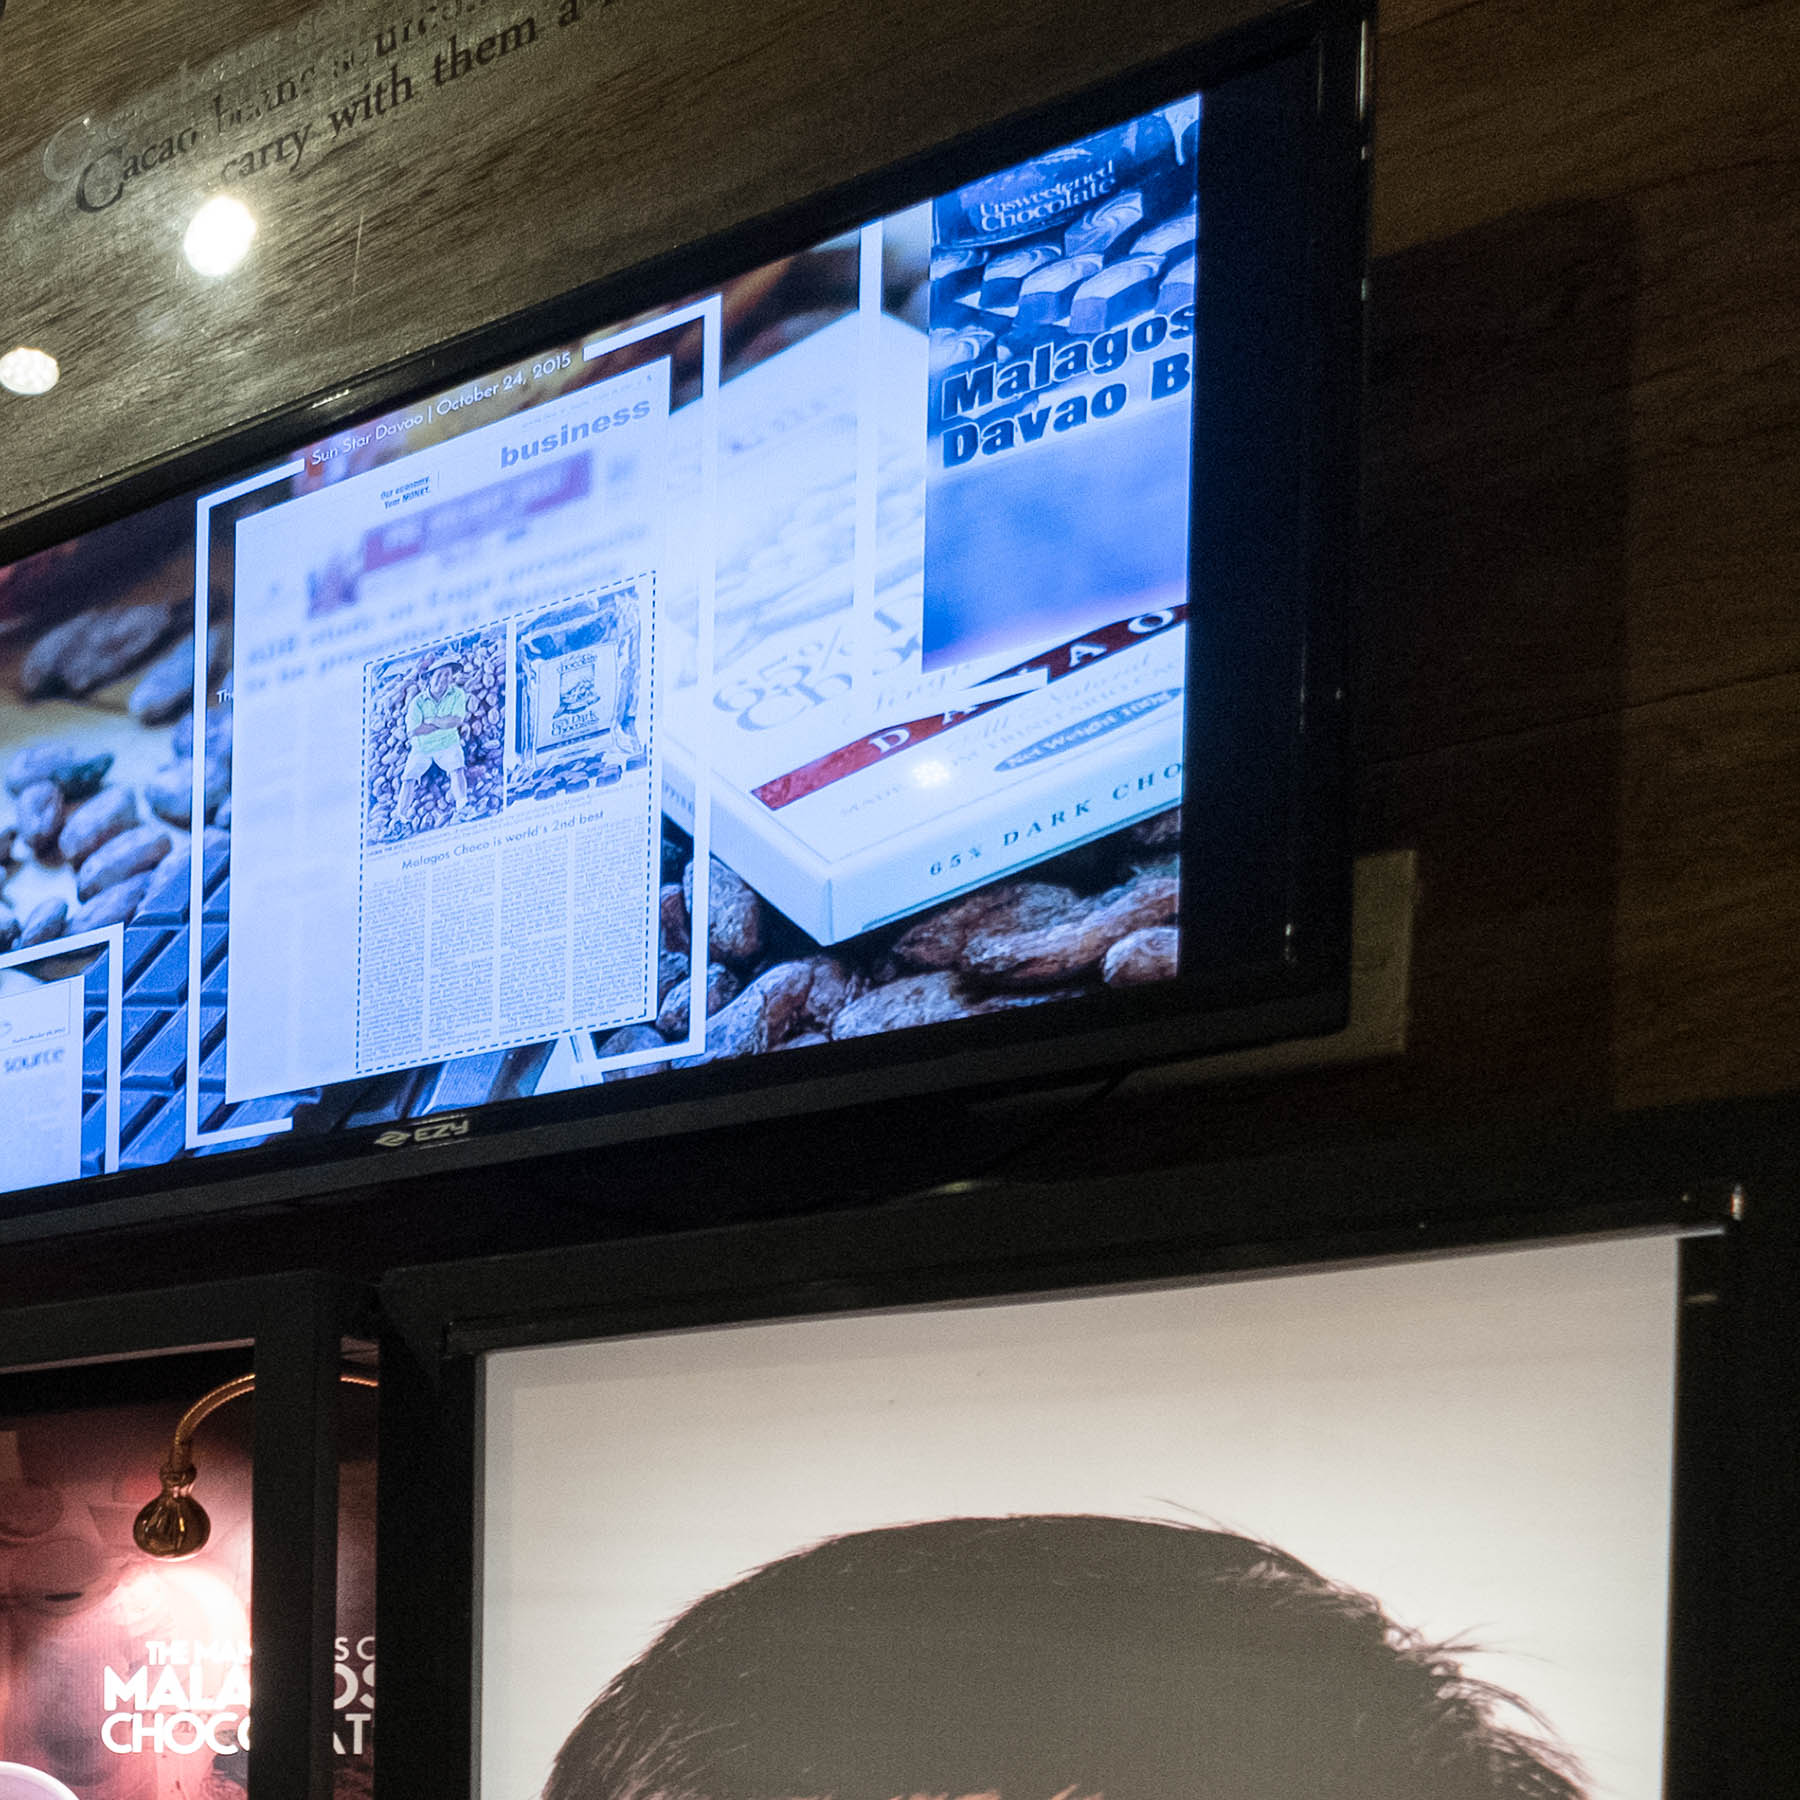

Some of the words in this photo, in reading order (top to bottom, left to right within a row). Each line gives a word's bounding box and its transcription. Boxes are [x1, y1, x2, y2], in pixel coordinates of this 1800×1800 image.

[220, 117, 311, 190] carry
[328, 68, 415, 138] with
[432, 12, 539, 86] them
[980, 160, 1114, 217] Unsweetened
[982, 177, 1116, 232] Chocolate
[942, 303, 1194, 419] Malagos
[311, 448, 338, 466] Sun
[343, 434, 372, 454] Star
[375, 414, 424, 441] Davao
[436, 382, 499, 416] October
[502, 372, 527, 392] 24,
[533, 353, 571, 380] 2015
[501, 400, 651, 468] business
[942, 382, 1129, 468] Davao
[401, 851, 450, 870] Malagos
[453, 840, 490, 857] Choco
[505, 825, 550, 846] world's
[552, 818, 576, 834] 2nd
[579, 810, 604, 828] best
[1003, 800, 1092, 848] DARK
[1112, 763, 1182, 801] CHO
[4, 1048, 65, 1076] source
